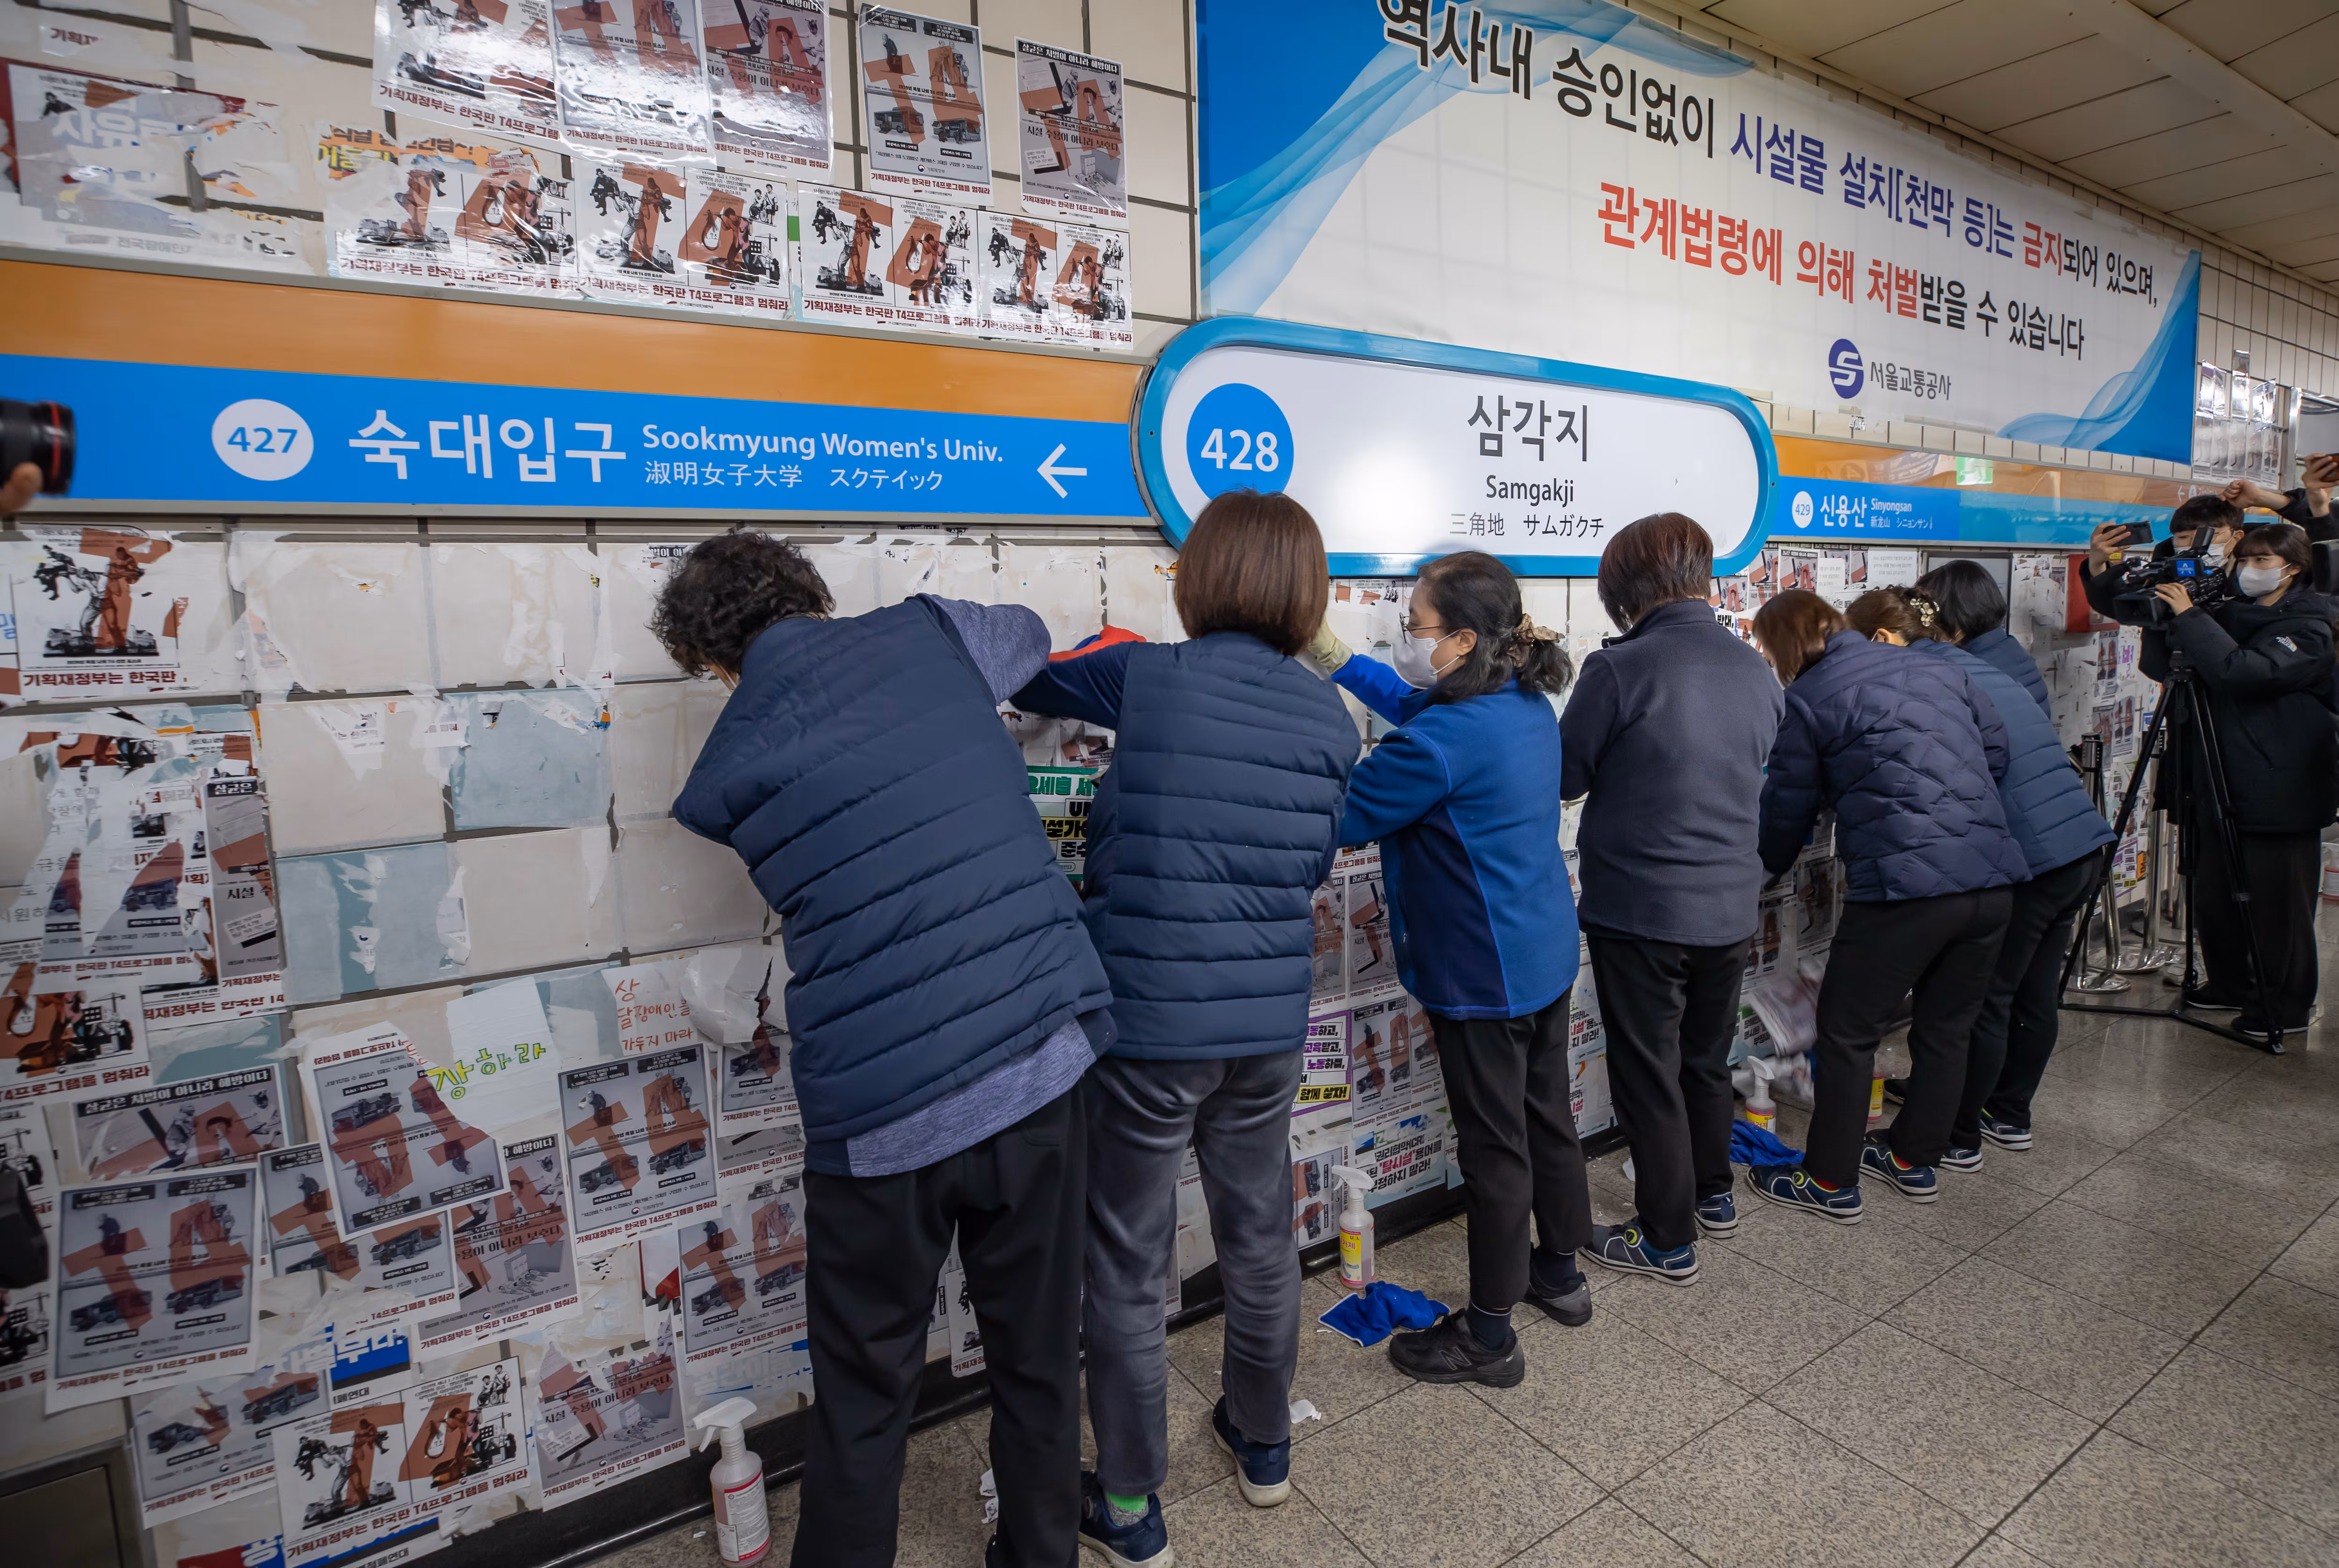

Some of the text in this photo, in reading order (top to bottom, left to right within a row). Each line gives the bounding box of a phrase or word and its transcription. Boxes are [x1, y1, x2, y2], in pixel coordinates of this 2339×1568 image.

[1023, 43, 1118, 73] 살균은 처벌이 아니라 해방이다
[379, 85, 455, 114] 기획재정부는
[459, 105, 496, 124] 한국판
[567, 130, 613, 142] 기획재정부는
[615, 135, 637, 145] 한국판
[639, 138, 684, 151] T4프로그램을
[1027, 125, 1118, 152] 시설 수용이 아니라 보호다
[743, 148, 764, 158] 한국판
[766, 152, 807, 166] T4프로그램을
[809, 160, 829, 169] 멈춰라
[1380, 0, 2158, 307] 역사내 승인없이 시설물 설치[천막 등]는 금지되어 있으며,
[871, 173, 990, 195] 기획재정부는 한국판 T4프로그램을 멈춰라
[1023, 195, 1056, 207] 기획재정부는
[1058, 201, 1075, 209] 한국판
[1076, 204, 1109, 215] T4프로그램을
[1597, 182, 2085, 361] 관계법령에 의해 처벌받을 수 있습니다
[582, 276, 789, 311] 기획재정부는 한국판 T4프로그램을 멈춰라
[804, 300, 862, 316] 기획재정부는
[865, 306, 893, 319] 한국판
[1110, 332, 1132, 342] 멈춰라
[1870, 361, 1952, 400] 서울교통공사
[227, 426, 298, 454] 427
[1467, 394, 1589, 463] 삼각지
[349, 409, 627, 483] 숙대입구
[643, 424, 1003, 463] Sookmyung Women's Univ.
[1200, 428, 1279, 472] 428
[644, 460, 803, 489] 淑明女子大学
[1485, 474, 1575, 506] Samgakji
[1795, 503, 1811, 516] 429
[1820, 494, 1867, 528] 신용산
[1871, 498, 1912, 514] Sinyongsan
[1449, 514, 1605, 539] 三角地 サムガクチ
[23, 670, 177, 686] 기획재정부는 한국판
[215, 783, 253, 793] 살균은
[1352, 874, 1367, 883] 살균은
[226, 886, 254, 899] 시설
[76, 962, 108, 971] 한국판
[222, 973, 281, 987] 기획재정부는
[665, 1028, 694, 1044] 마라
[102, 1064, 151, 1085] 멈춰라
[175, 1080, 214, 1097] 아니라
[218, 1069, 269, 1090] 해방이다
[1300, 1088, 1321, 1100] 함께
[723, 1106, 782, 1121] 기획재정부는 한국판
[513, 1138, 553, 1154] 해방이다
[719, 1157, 782, 1179] 기획재정부는 한국판
[1409, 1158, 1431, 1178] 말라!
[576, 1200, 718, 1244] 기획재정부는 한국판 T4프로그램을 멈춰라
[489, 1235, 523, 1252] 아니라
[371, 1292, 455, 1321] T4프로그램을 멈춰라
[421, 1296, 579, 1349] 기획재정부는 한국판 T4프로그램을 멈춰라
[686, 1325, 794, 1363] 기획재정부는 한국판 T4프로그램을
[545, 1409, 565, 1423] 시설
[605, 1387, 636, 1404] 아니라
[543, 1439, 685, 1498] 기획재정부는 한국판 T4프로그램을 멈춰라
[286, 1520, 368, 1559] 기획재정부는
[372, 1508, 410, 1529] 한국판
[414, 1481, 490, 1516] T4프로그램을
[493, 1469, 528, 1488] 멈춰라
